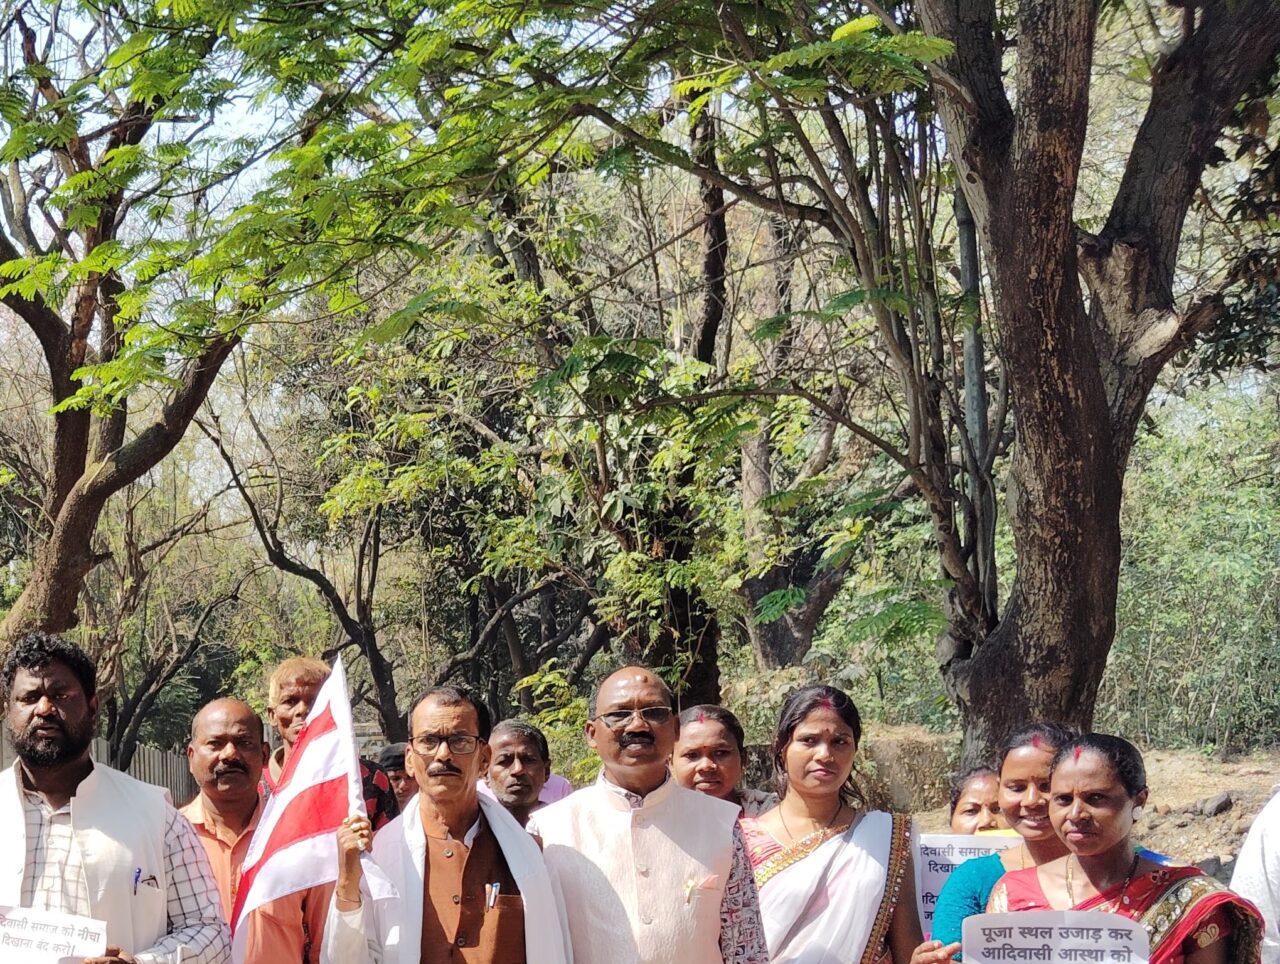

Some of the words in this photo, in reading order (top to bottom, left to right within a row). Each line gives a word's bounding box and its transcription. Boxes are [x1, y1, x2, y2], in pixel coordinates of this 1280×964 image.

[920, 844, 955, 857] दिवासी
[62, 924, 75, 937] को
[78, 927, 101, 943] नीचा
[981, 927, 1013, 943] पूजा
[1018, 927, 1053, 940] स्थल
[1058, 927, 1103, 943] उजाड़
[1108, 928, 1133, 941] कर
[981, 943, 1053, 961] आदिवासी
[1058, 948, 1105, 962] आस्था
[1110, 946, 1132, 963] को
